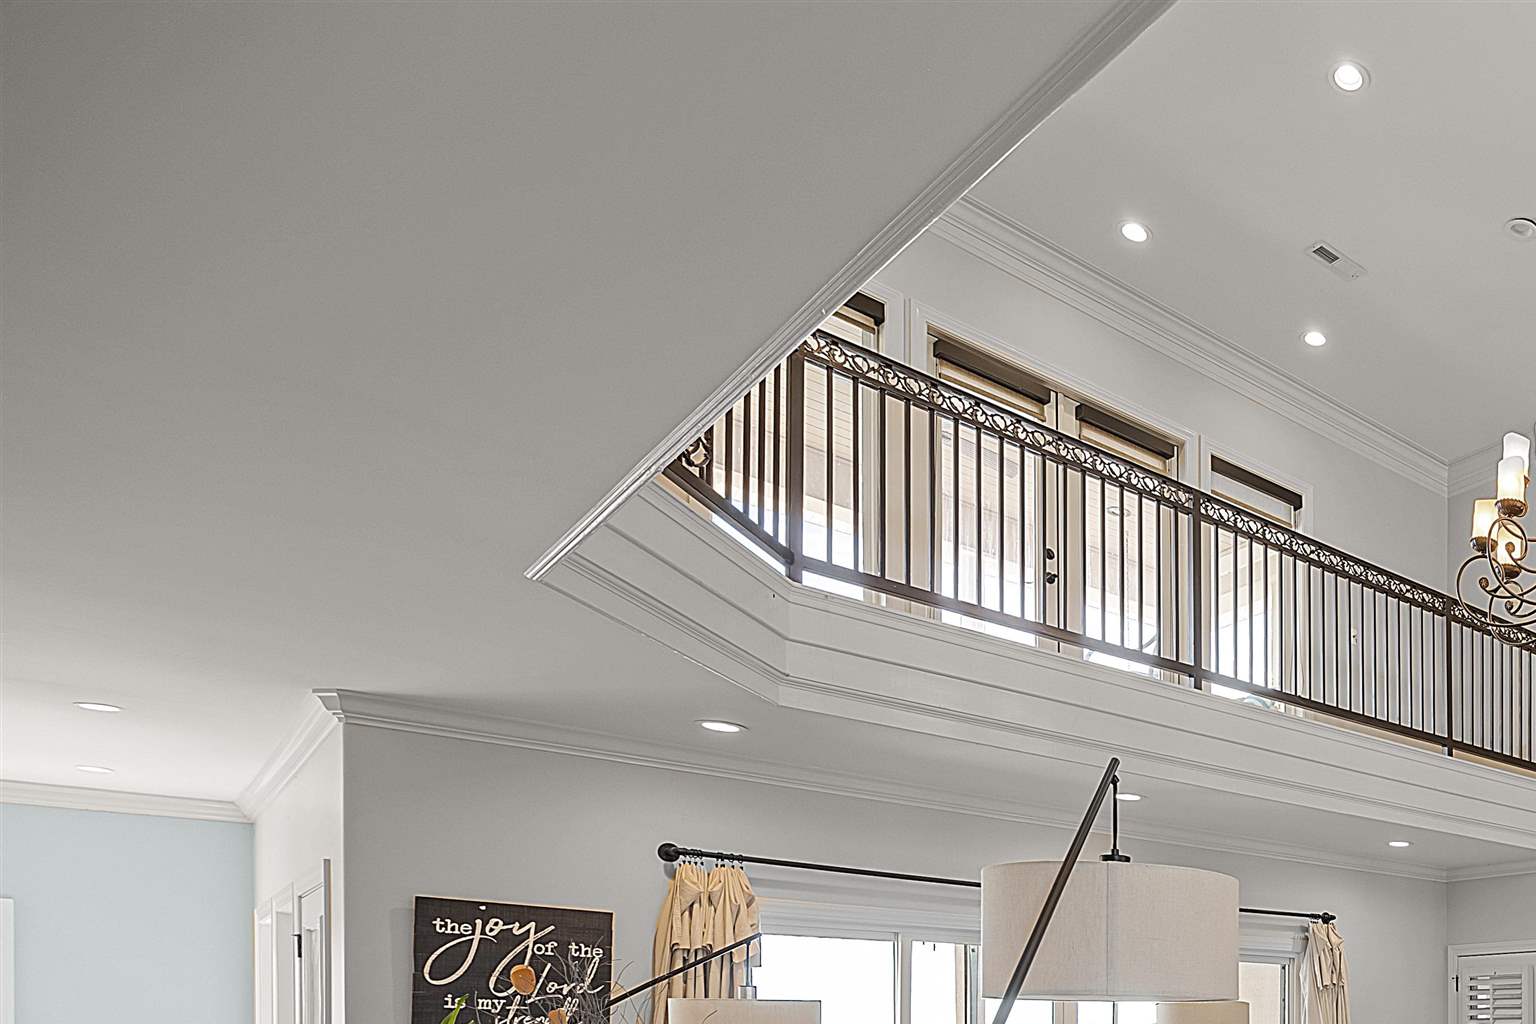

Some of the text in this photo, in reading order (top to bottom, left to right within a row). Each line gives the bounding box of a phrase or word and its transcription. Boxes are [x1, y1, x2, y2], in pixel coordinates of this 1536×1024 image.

[423, 905, 556, 997] the joy
[533, 941, 604, 958] of the
[525, 957, 605, 1004] Lord
[443, 994, 507, 1013] is my
